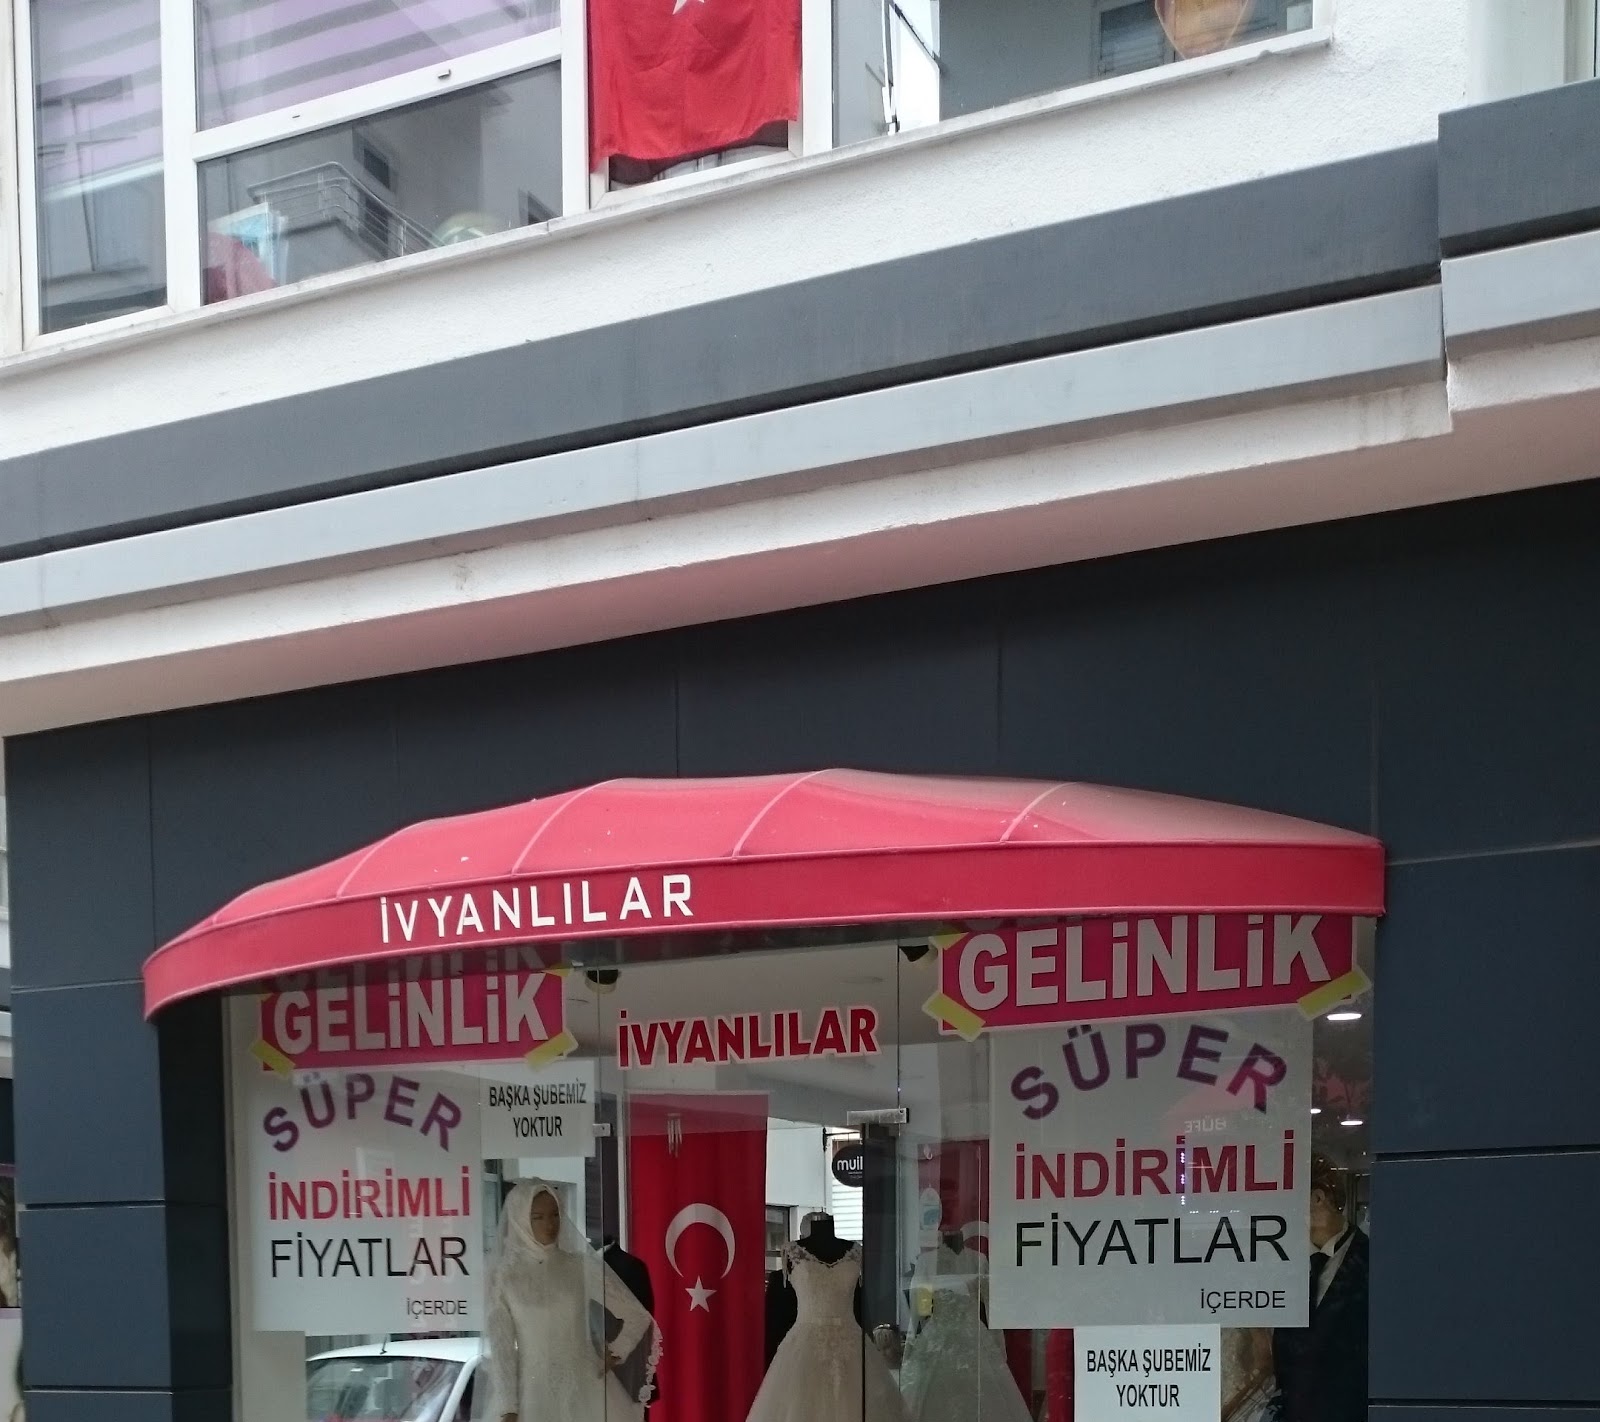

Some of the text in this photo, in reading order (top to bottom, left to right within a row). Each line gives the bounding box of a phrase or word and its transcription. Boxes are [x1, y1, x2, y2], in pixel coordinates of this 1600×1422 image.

[618, 1006, 880, 1068] İVYANLILAR
[1010, 1023, 1288, 1120] SÜPER
[263, 1072, 463, 1152] SÜPER
[489, 1077, 587, 1111] BAŞKA ŞUBEMİZ
[513, 1115, 563, 1138] YOKTUR
[836, 1155, 864, 1171] muil
[1015, 1129, 1295, 1200] İNDİRİMLİ
[268, 1165, 471, 1220] İNDİRİMLİ
[271, 1232, 470, 1278] FİYATLAR
[1015, 1212, 1291, 1267] FİYATLAR
[406, 1298, 468, 1320] İÇERDE
[1200, 1288, 1287, 1314] İÇERDE
[1086, 1342, 1212, 1378] BAŞKA ŞUBEMİZ
[1115, 1384, 1181, 1407] YOKTUR
